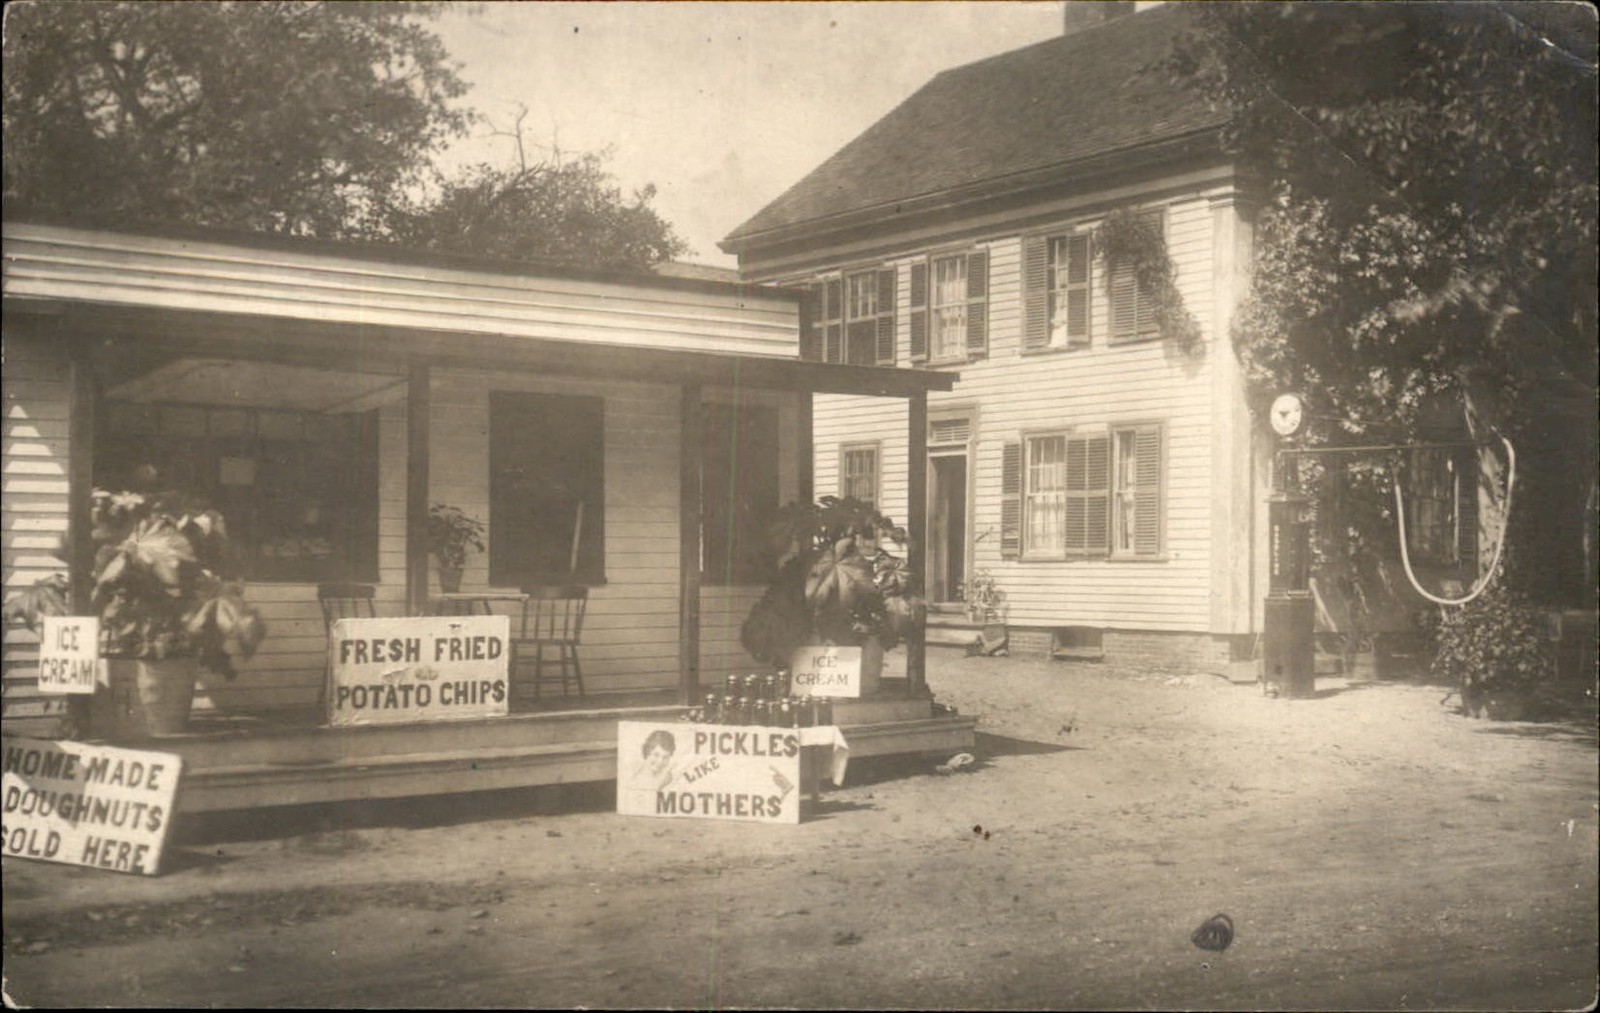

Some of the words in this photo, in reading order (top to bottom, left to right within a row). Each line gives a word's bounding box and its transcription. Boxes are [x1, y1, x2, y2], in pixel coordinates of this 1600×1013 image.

[56, 625, 80, 651] ICE
[340, 637, 420, 665] FRESH
[434, 636, 502, 662] FRIED
[40, 657, 93, 686] CREAM
[812, 656, 838, 668] ICE
[796, 673, 849, 686] CREAM
[336, 684, 432, 710] POTATO
[439, 679, 505, 706] CHIPS
[694, 731, 798, 758] PICKLES
[4, 747, 81, 781] HOME
[85, 756, 164, 792] MADE
[683, 756, 720, 783] LIKE
[4, 786, 164, 833] DOUGHNUTS
[656, 791, 782, 817] MOTHERS
[81, 835, 150, 874] HERE
